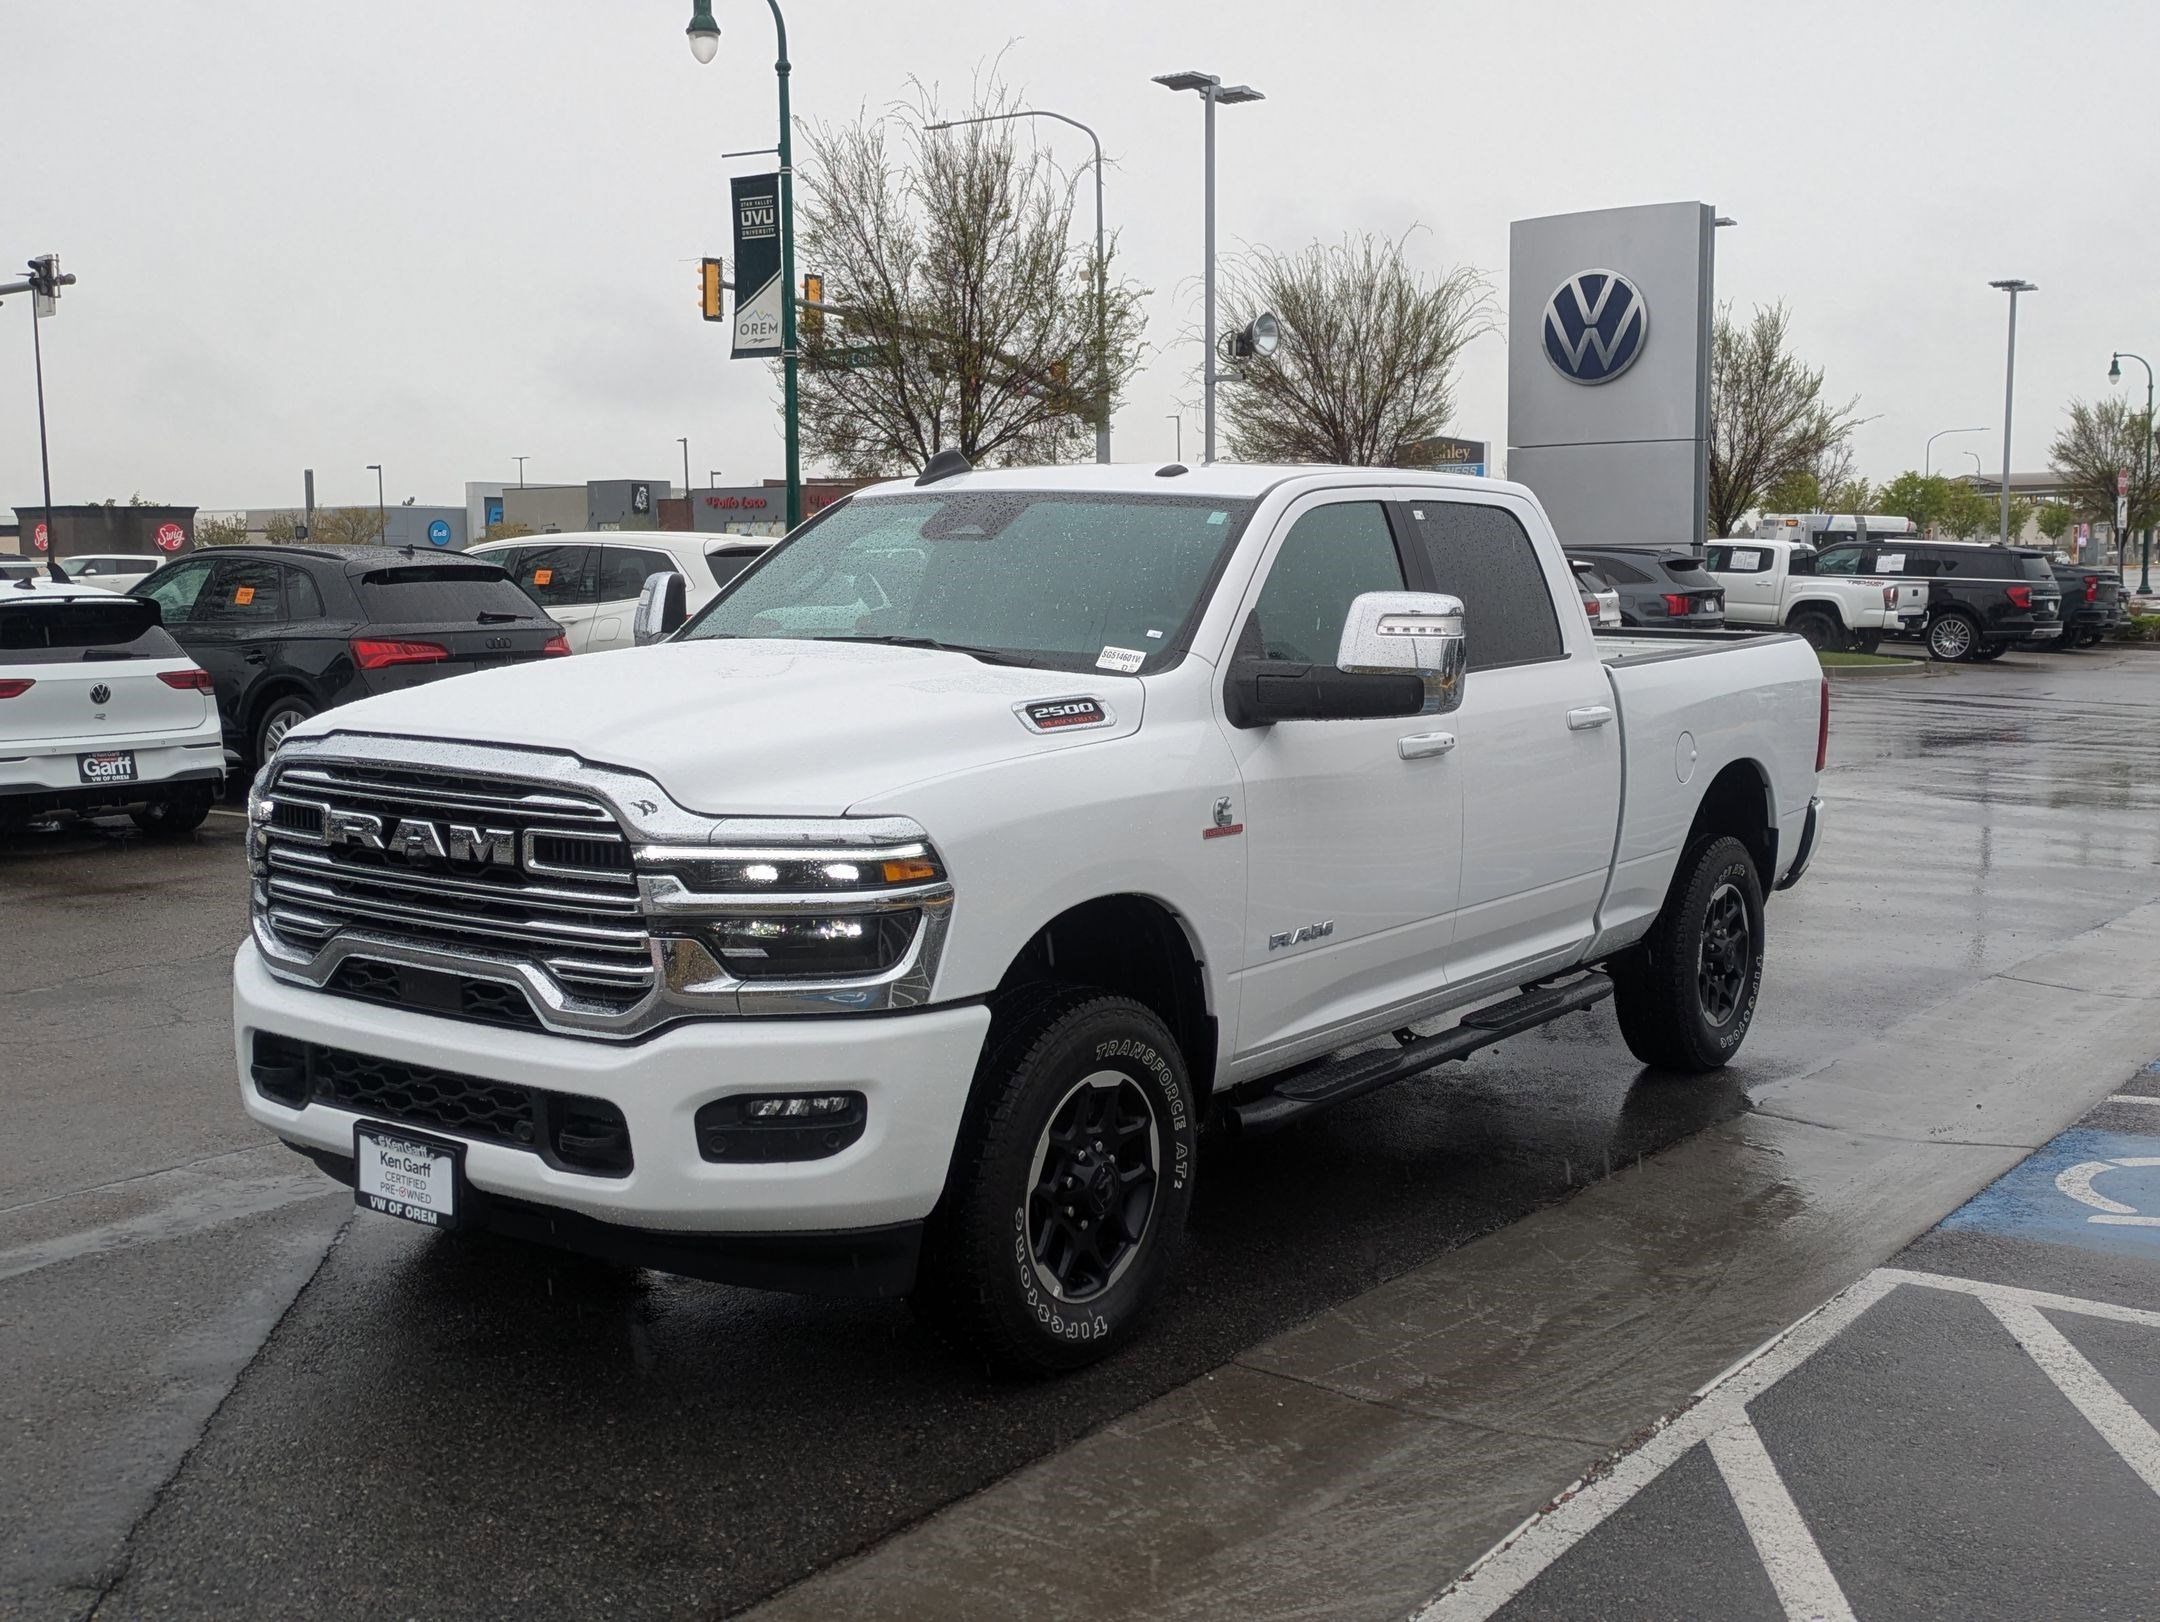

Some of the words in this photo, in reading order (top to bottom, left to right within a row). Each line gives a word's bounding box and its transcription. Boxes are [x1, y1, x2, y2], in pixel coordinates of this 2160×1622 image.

[741, 208, 774, 226] UVU
[741, 227, 775, 236] UNIVERSITY
[739, 322, 778, 336] OREM
[157, 527, 185, 546] Swig
[1033, 702, 1095, 719] 2500
[83, 756, 131, 776] Garff
[331, 809, 515, 866] RAM
[1268, 920, 1334, 952] RAM
[1096, 1039, 1187, 1131] TRANSFORCE
[380, 1150, 402, 1170] Ken
[403, 1157, 431, 1178] Garff
[384, 1170, 427, 1191] CERTIFIED
[369, 1195, 387, 1211] VW
[388, 1201, 403, 1216] OF
[405, 1205, 438, 1225] OREM
